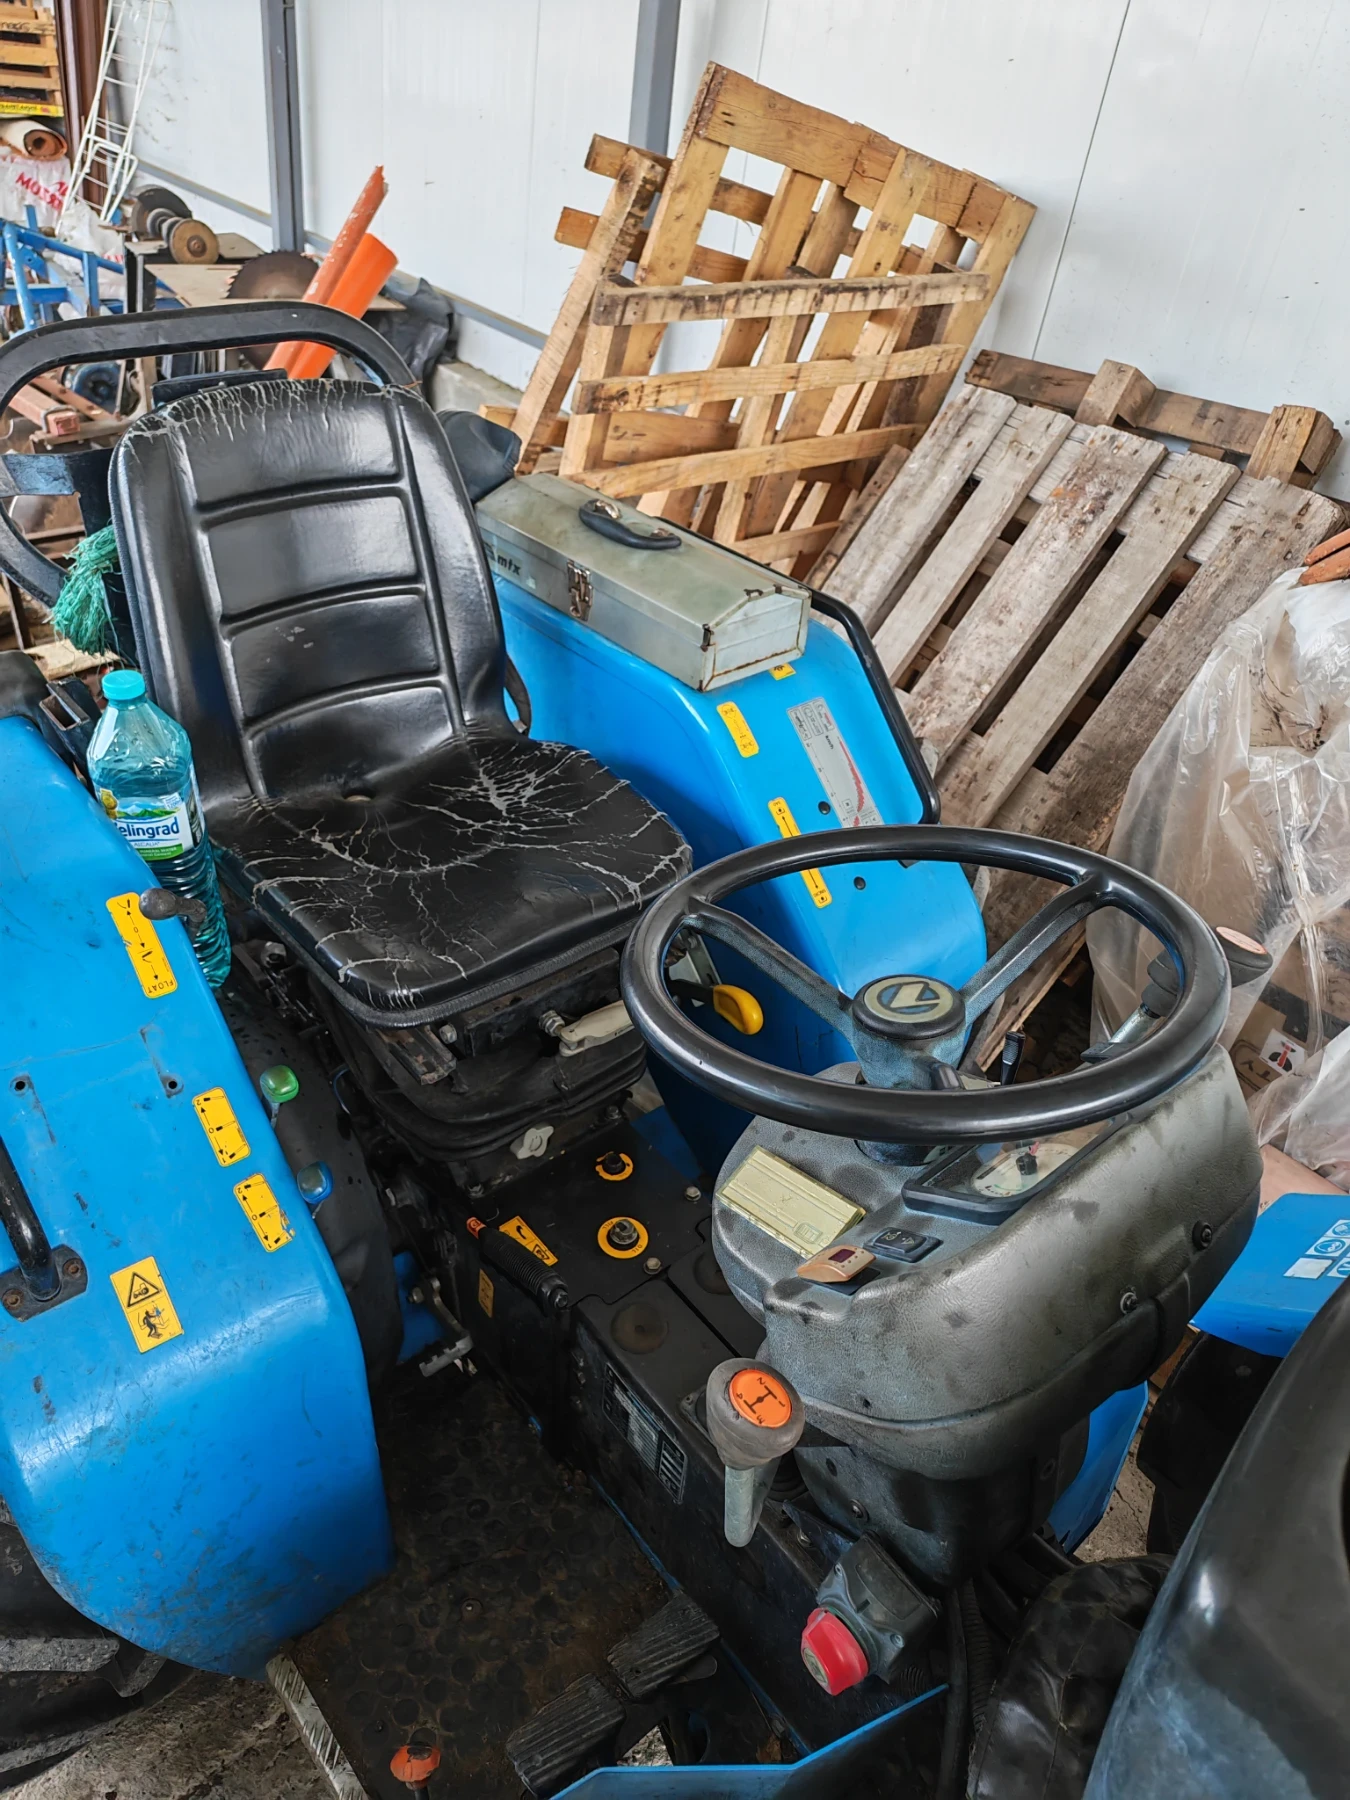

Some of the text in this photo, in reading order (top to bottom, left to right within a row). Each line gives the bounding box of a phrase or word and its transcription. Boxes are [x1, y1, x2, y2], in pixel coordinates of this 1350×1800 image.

[113, 816, 180, 839] elingrad
[147, 979, 174, 994] FLOAT
[603, 1220, 614, 1230] FILL
[631, 1244, 643, 1254] OIL
[757, 1376, 766, 1386] 2
[756, 1414, 766, 1425] 3
